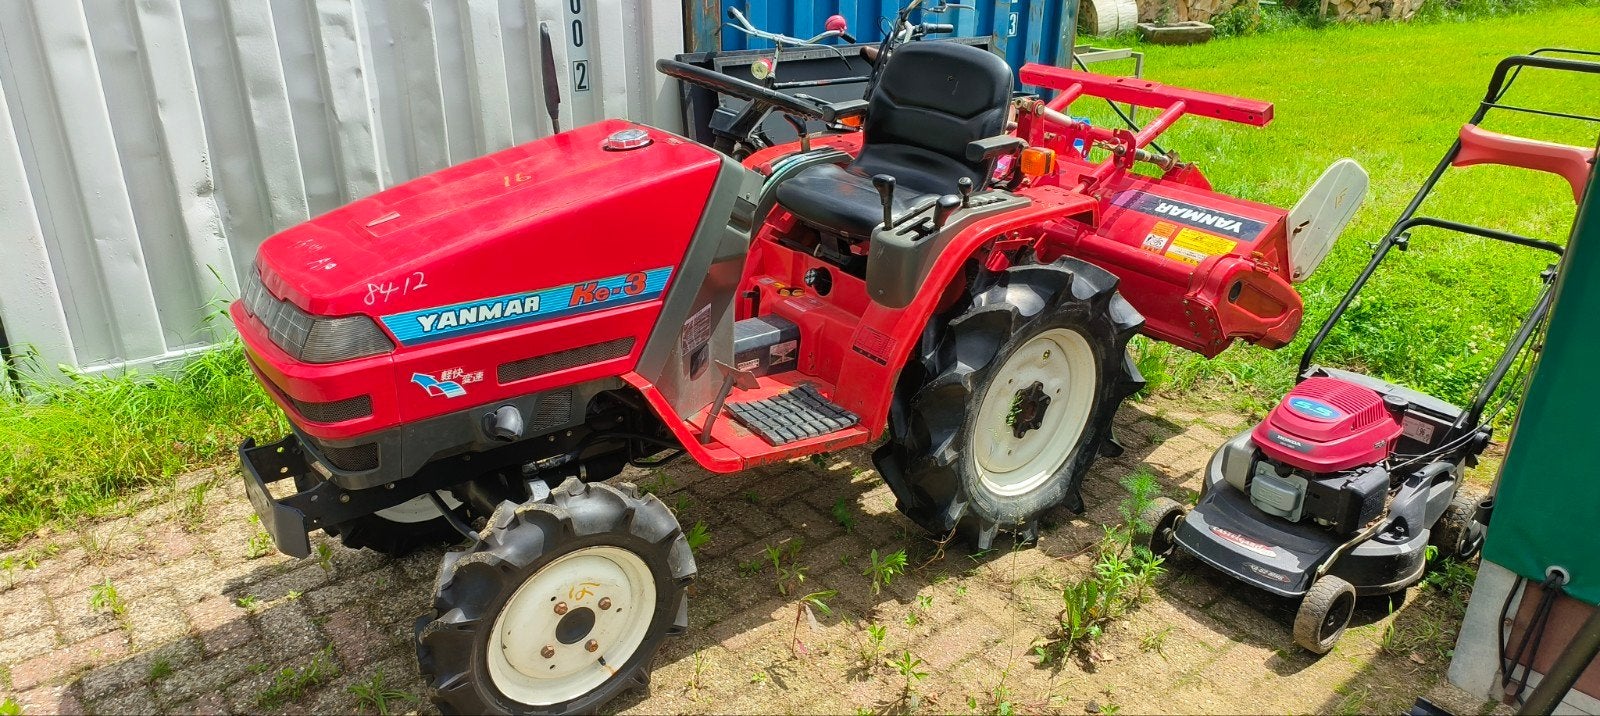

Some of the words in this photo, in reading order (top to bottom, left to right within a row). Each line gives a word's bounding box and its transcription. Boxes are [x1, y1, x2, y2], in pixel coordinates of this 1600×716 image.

[1008, 13, 1017, 35] 3
[1154, 201, 1243, 234] YANMAR
[416, 295, 541, 333] YANMAR
[568, 271, 648, 306] Ke-3
[1293, 400, 1333, 417] 5.5
